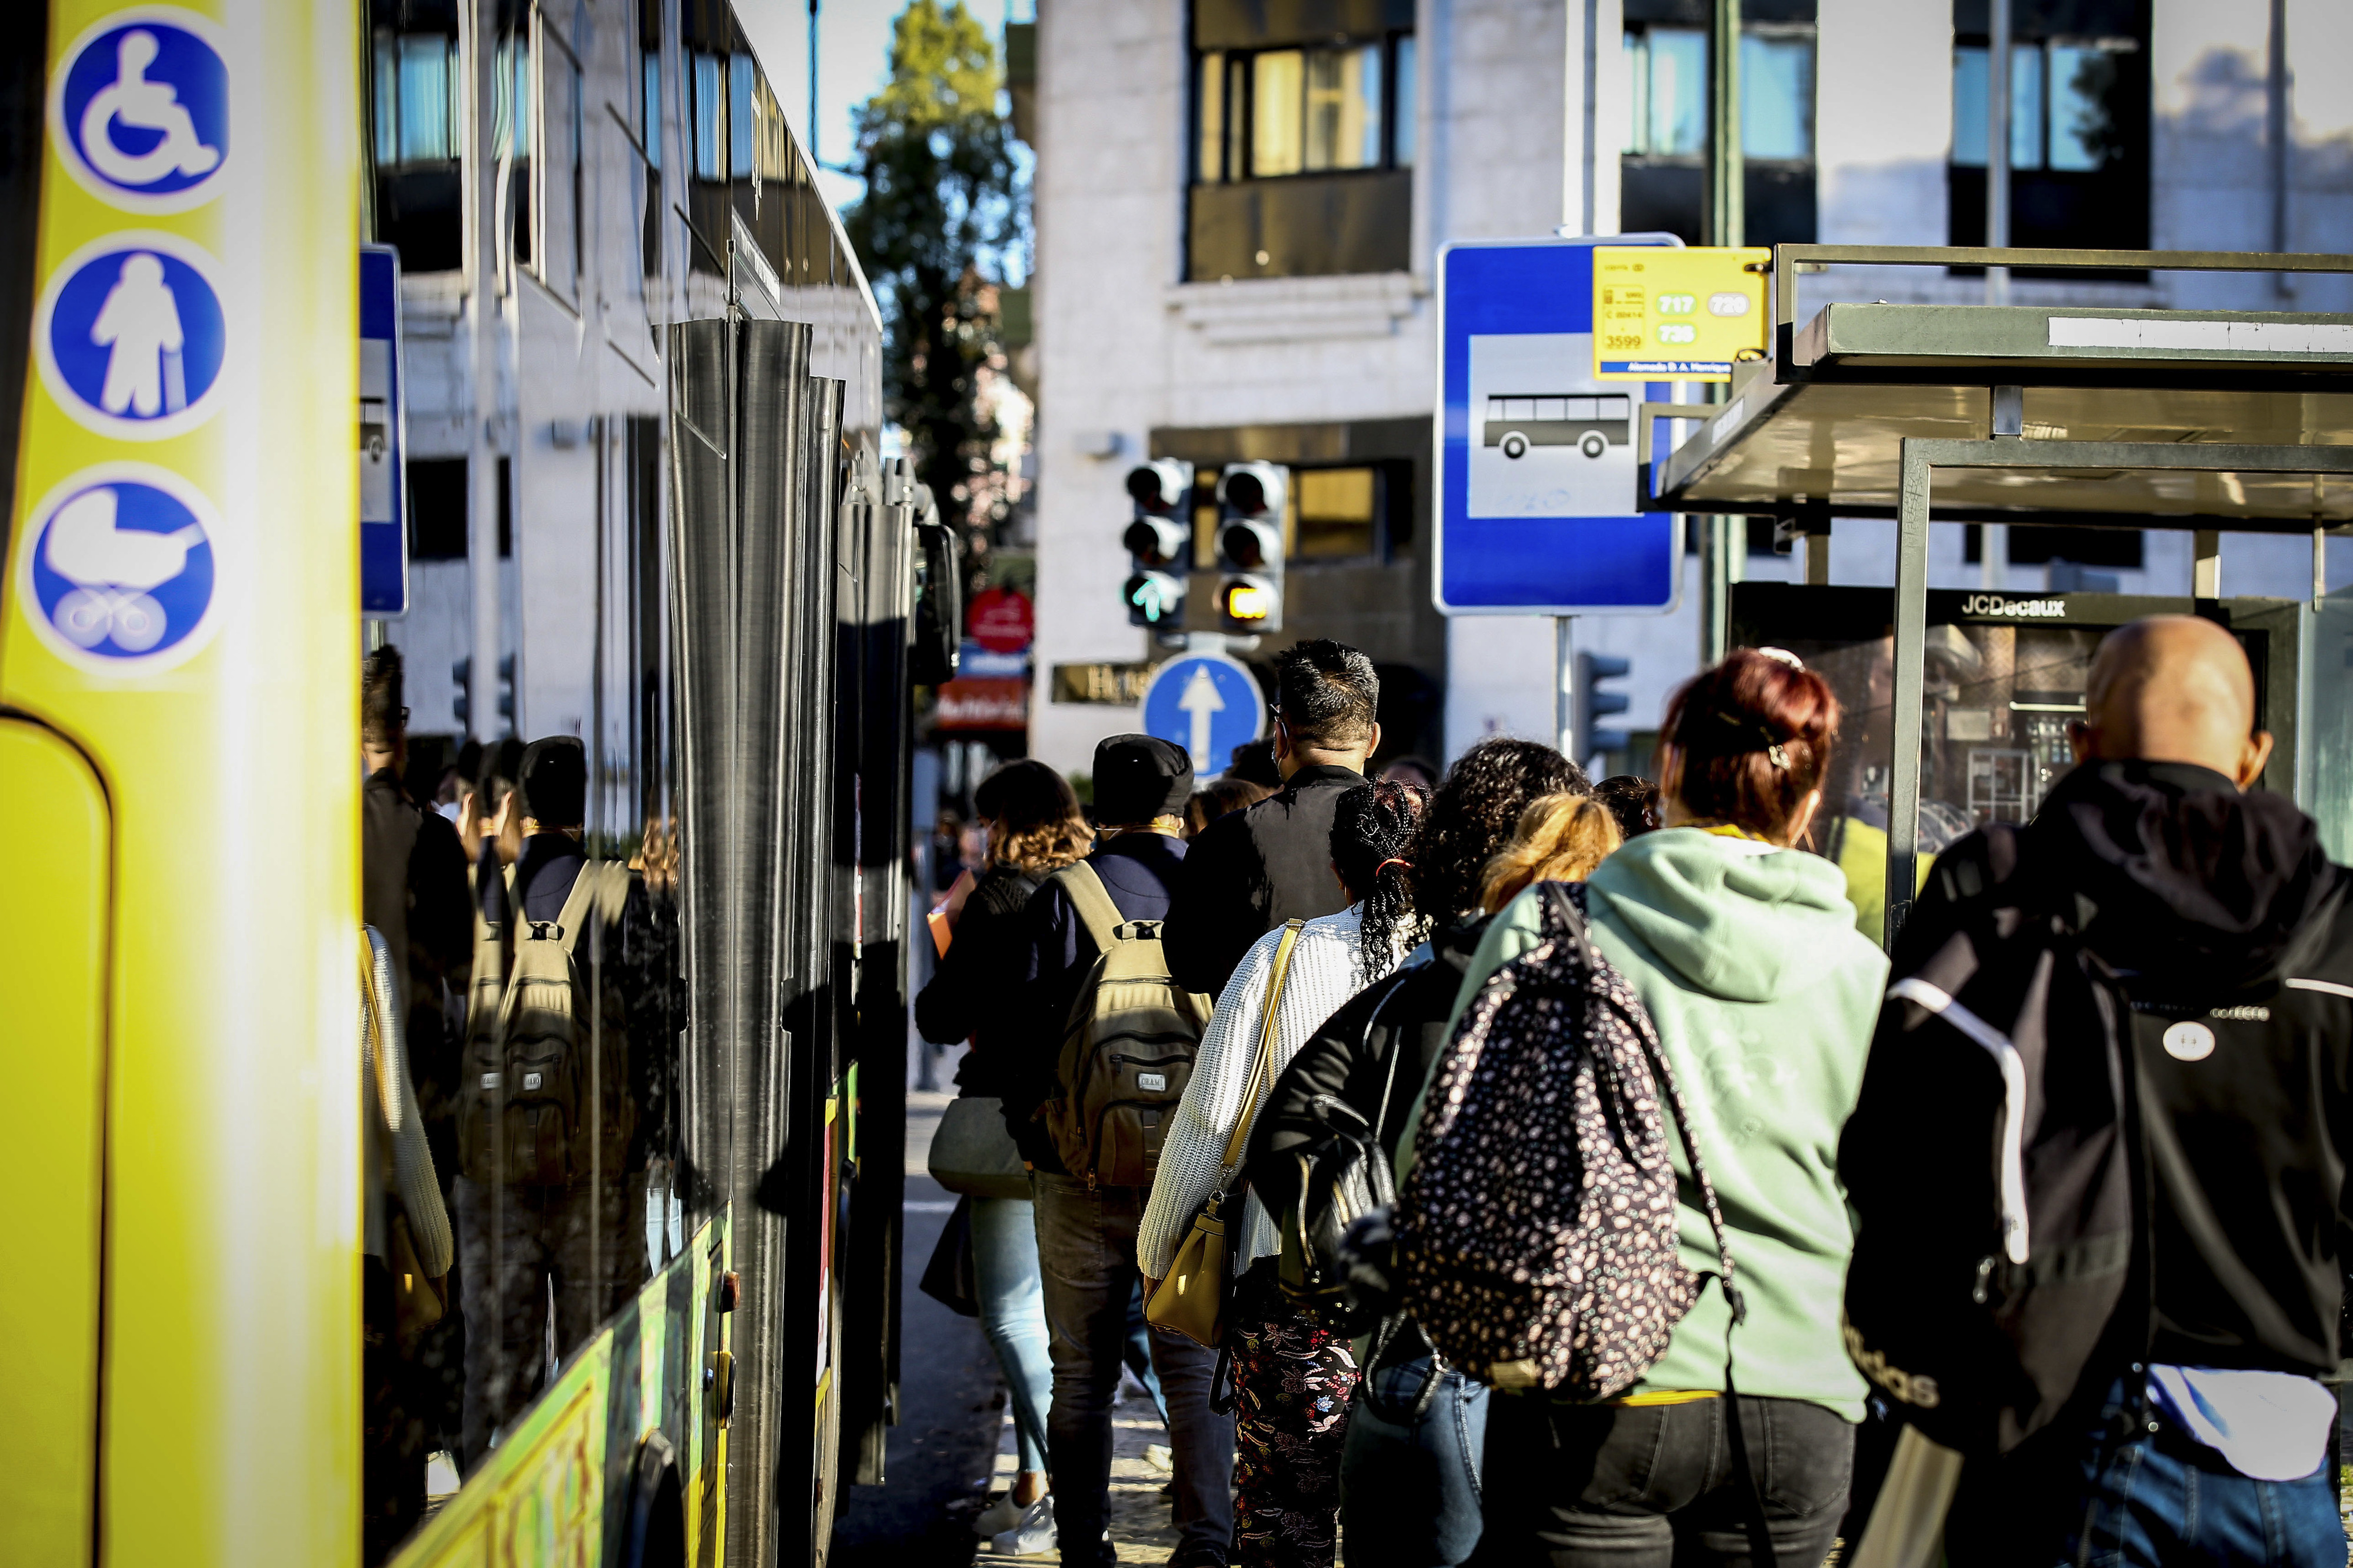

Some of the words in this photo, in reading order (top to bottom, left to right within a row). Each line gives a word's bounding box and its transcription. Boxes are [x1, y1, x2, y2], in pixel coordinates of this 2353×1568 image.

[1659, 296, 1694, 312] 717
[1606, 335, 1641, 348] 3599
[1962, 594, 2066, 617] JCDecaux
